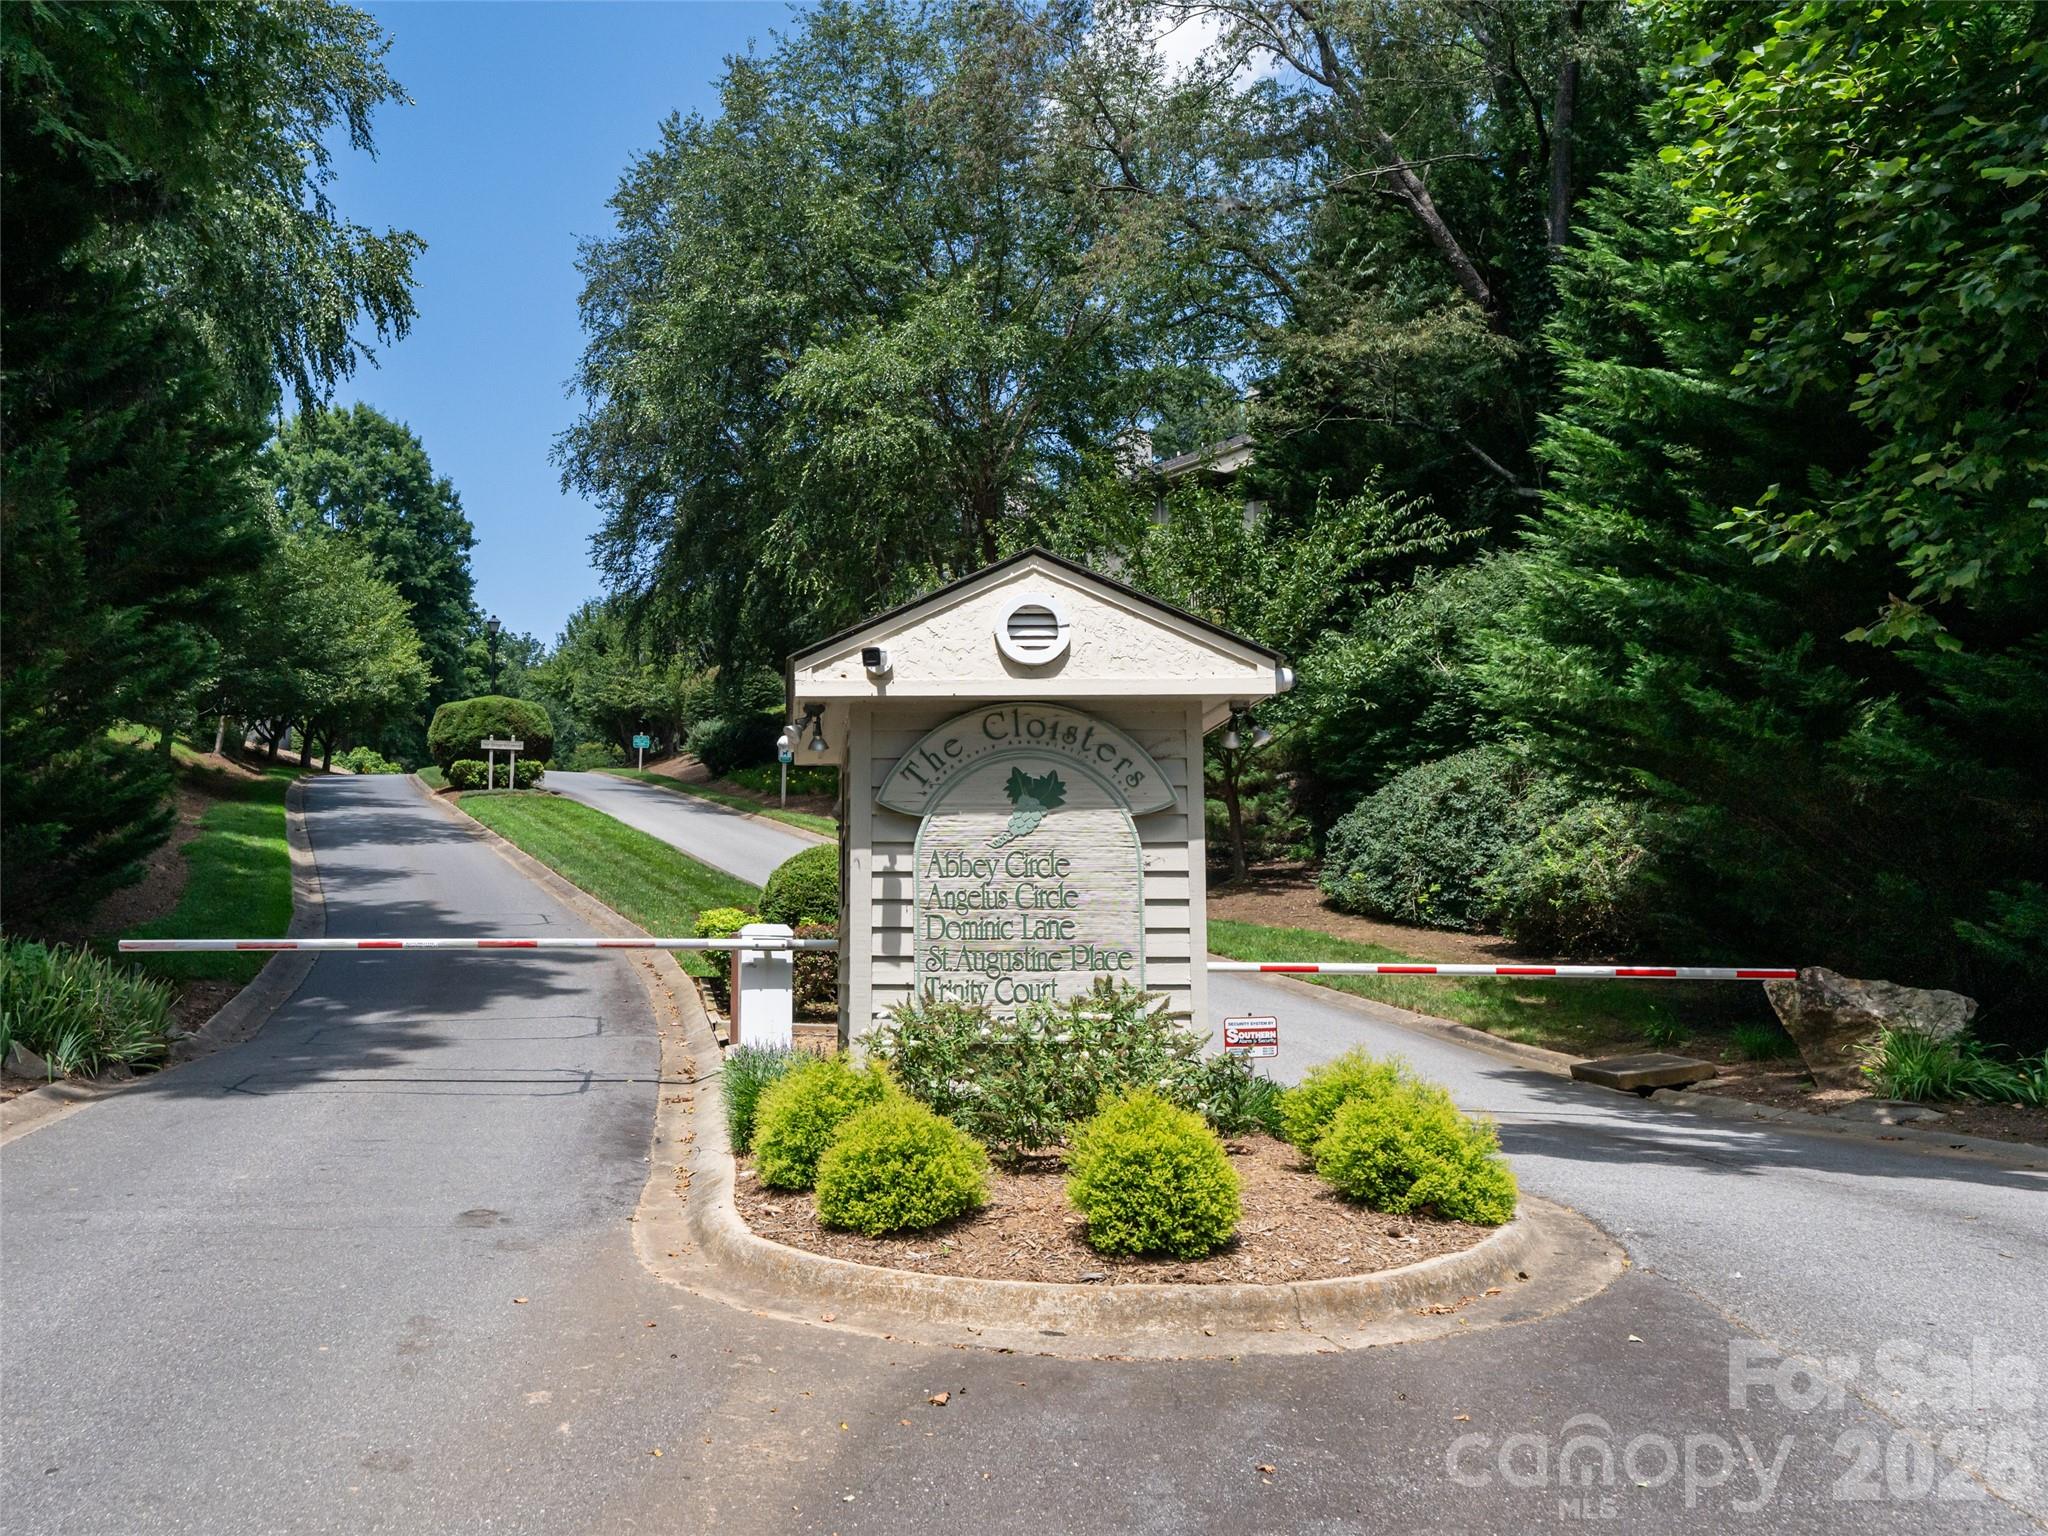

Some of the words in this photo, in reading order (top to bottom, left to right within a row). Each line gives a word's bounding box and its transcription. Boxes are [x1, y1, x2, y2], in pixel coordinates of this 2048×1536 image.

[901, 736, 963, 788] The
[982, 708, 1146, 788] Cloisters
[925, 849, 999, 886] Abbey
[1005, 849, 1071, 879] Circle
[925, 882, 1008, 916] Angelus
[1015, 881, 1079, 910] Circle
[925, 914, 1013, 940] Dominic
[1020, 913, 1075, 940] Lane
[953, 945, 1063, 979] Augustine
[1070, 944, 1133, 972] Place
[925, 976, 988, 1005] Trinity
[994, 977, 1058, 1006] Court
[1226, 1029, 1277, 1044] SOUTHERN
